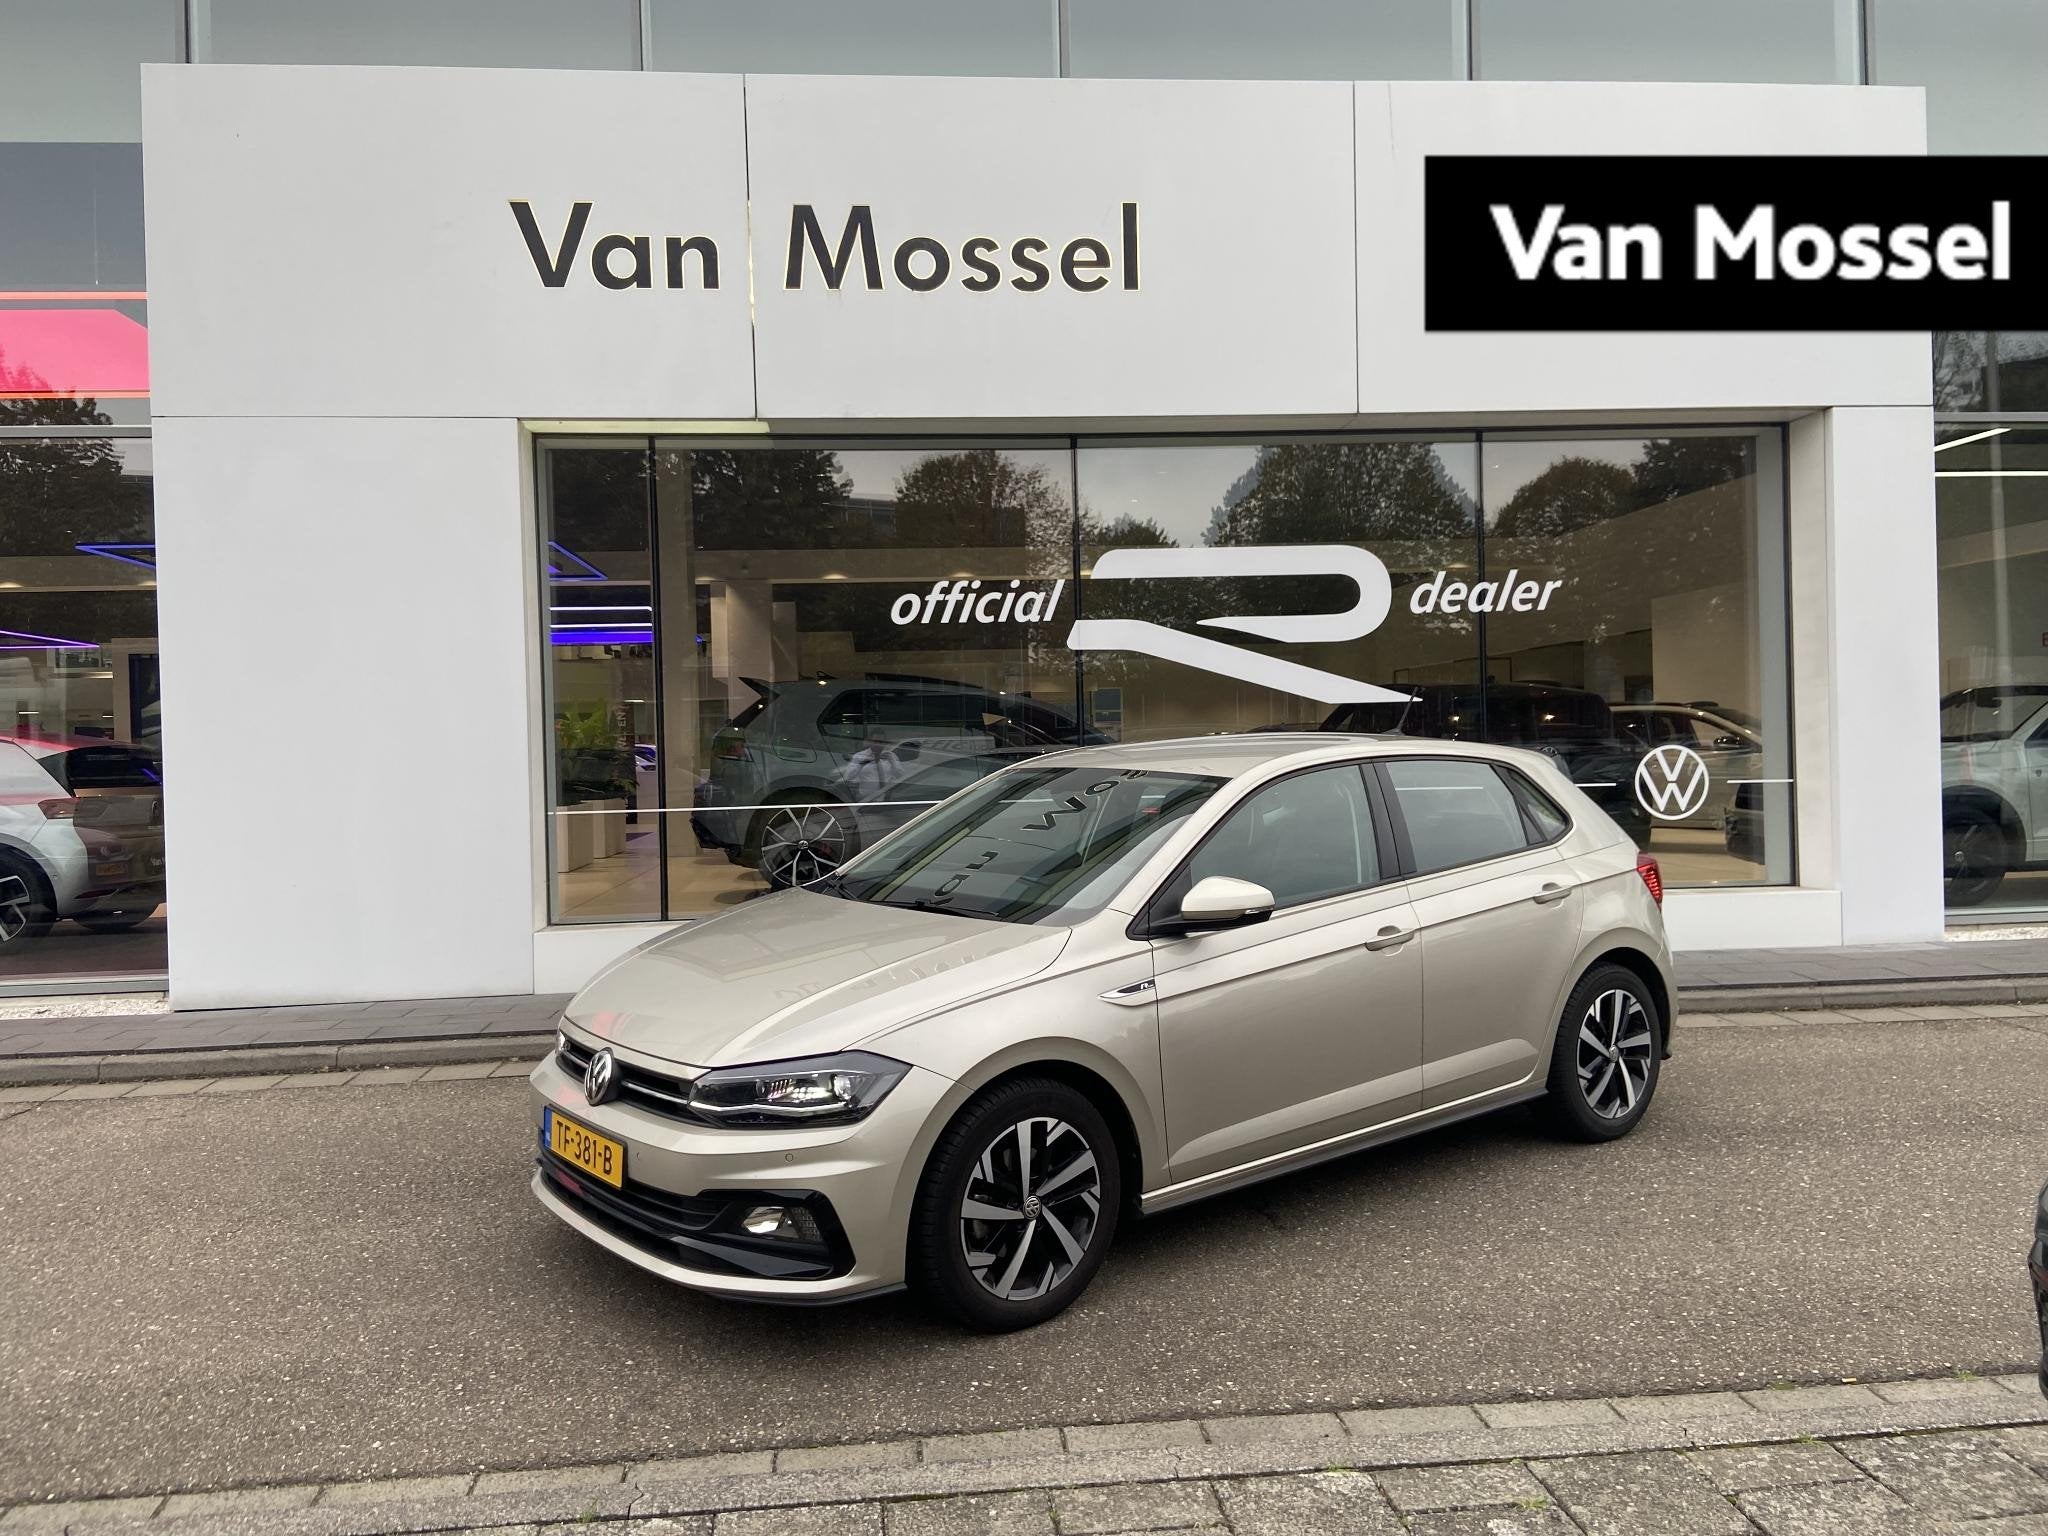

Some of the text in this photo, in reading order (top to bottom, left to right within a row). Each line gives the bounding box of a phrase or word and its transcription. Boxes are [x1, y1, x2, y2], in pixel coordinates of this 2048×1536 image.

[508, 200, 1140, 293] Van Mossel
[890, 578, 1066, 625] official
[1409, 568, 1564, 614] dealer
[556, 1119, 613, 1176] TF-381-B
